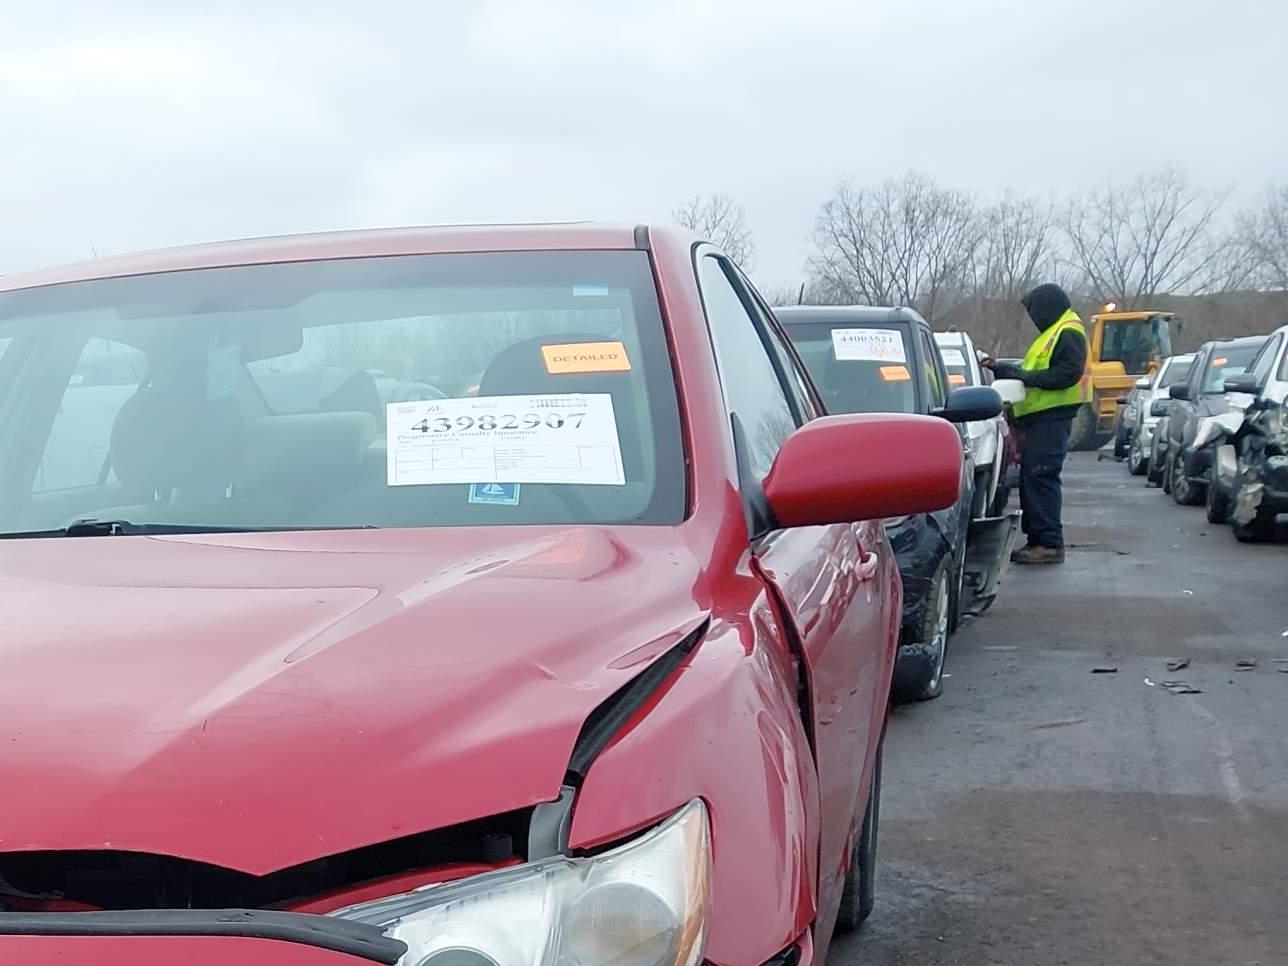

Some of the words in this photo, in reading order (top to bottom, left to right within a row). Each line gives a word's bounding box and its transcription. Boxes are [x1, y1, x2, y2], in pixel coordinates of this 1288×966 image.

[553, 353, 618, 363] DETAILED
[410, 412, 587, 433] 43982907
[397, 432, 449, 441] Progressive
[494, 429, 538, 437] Insurance
